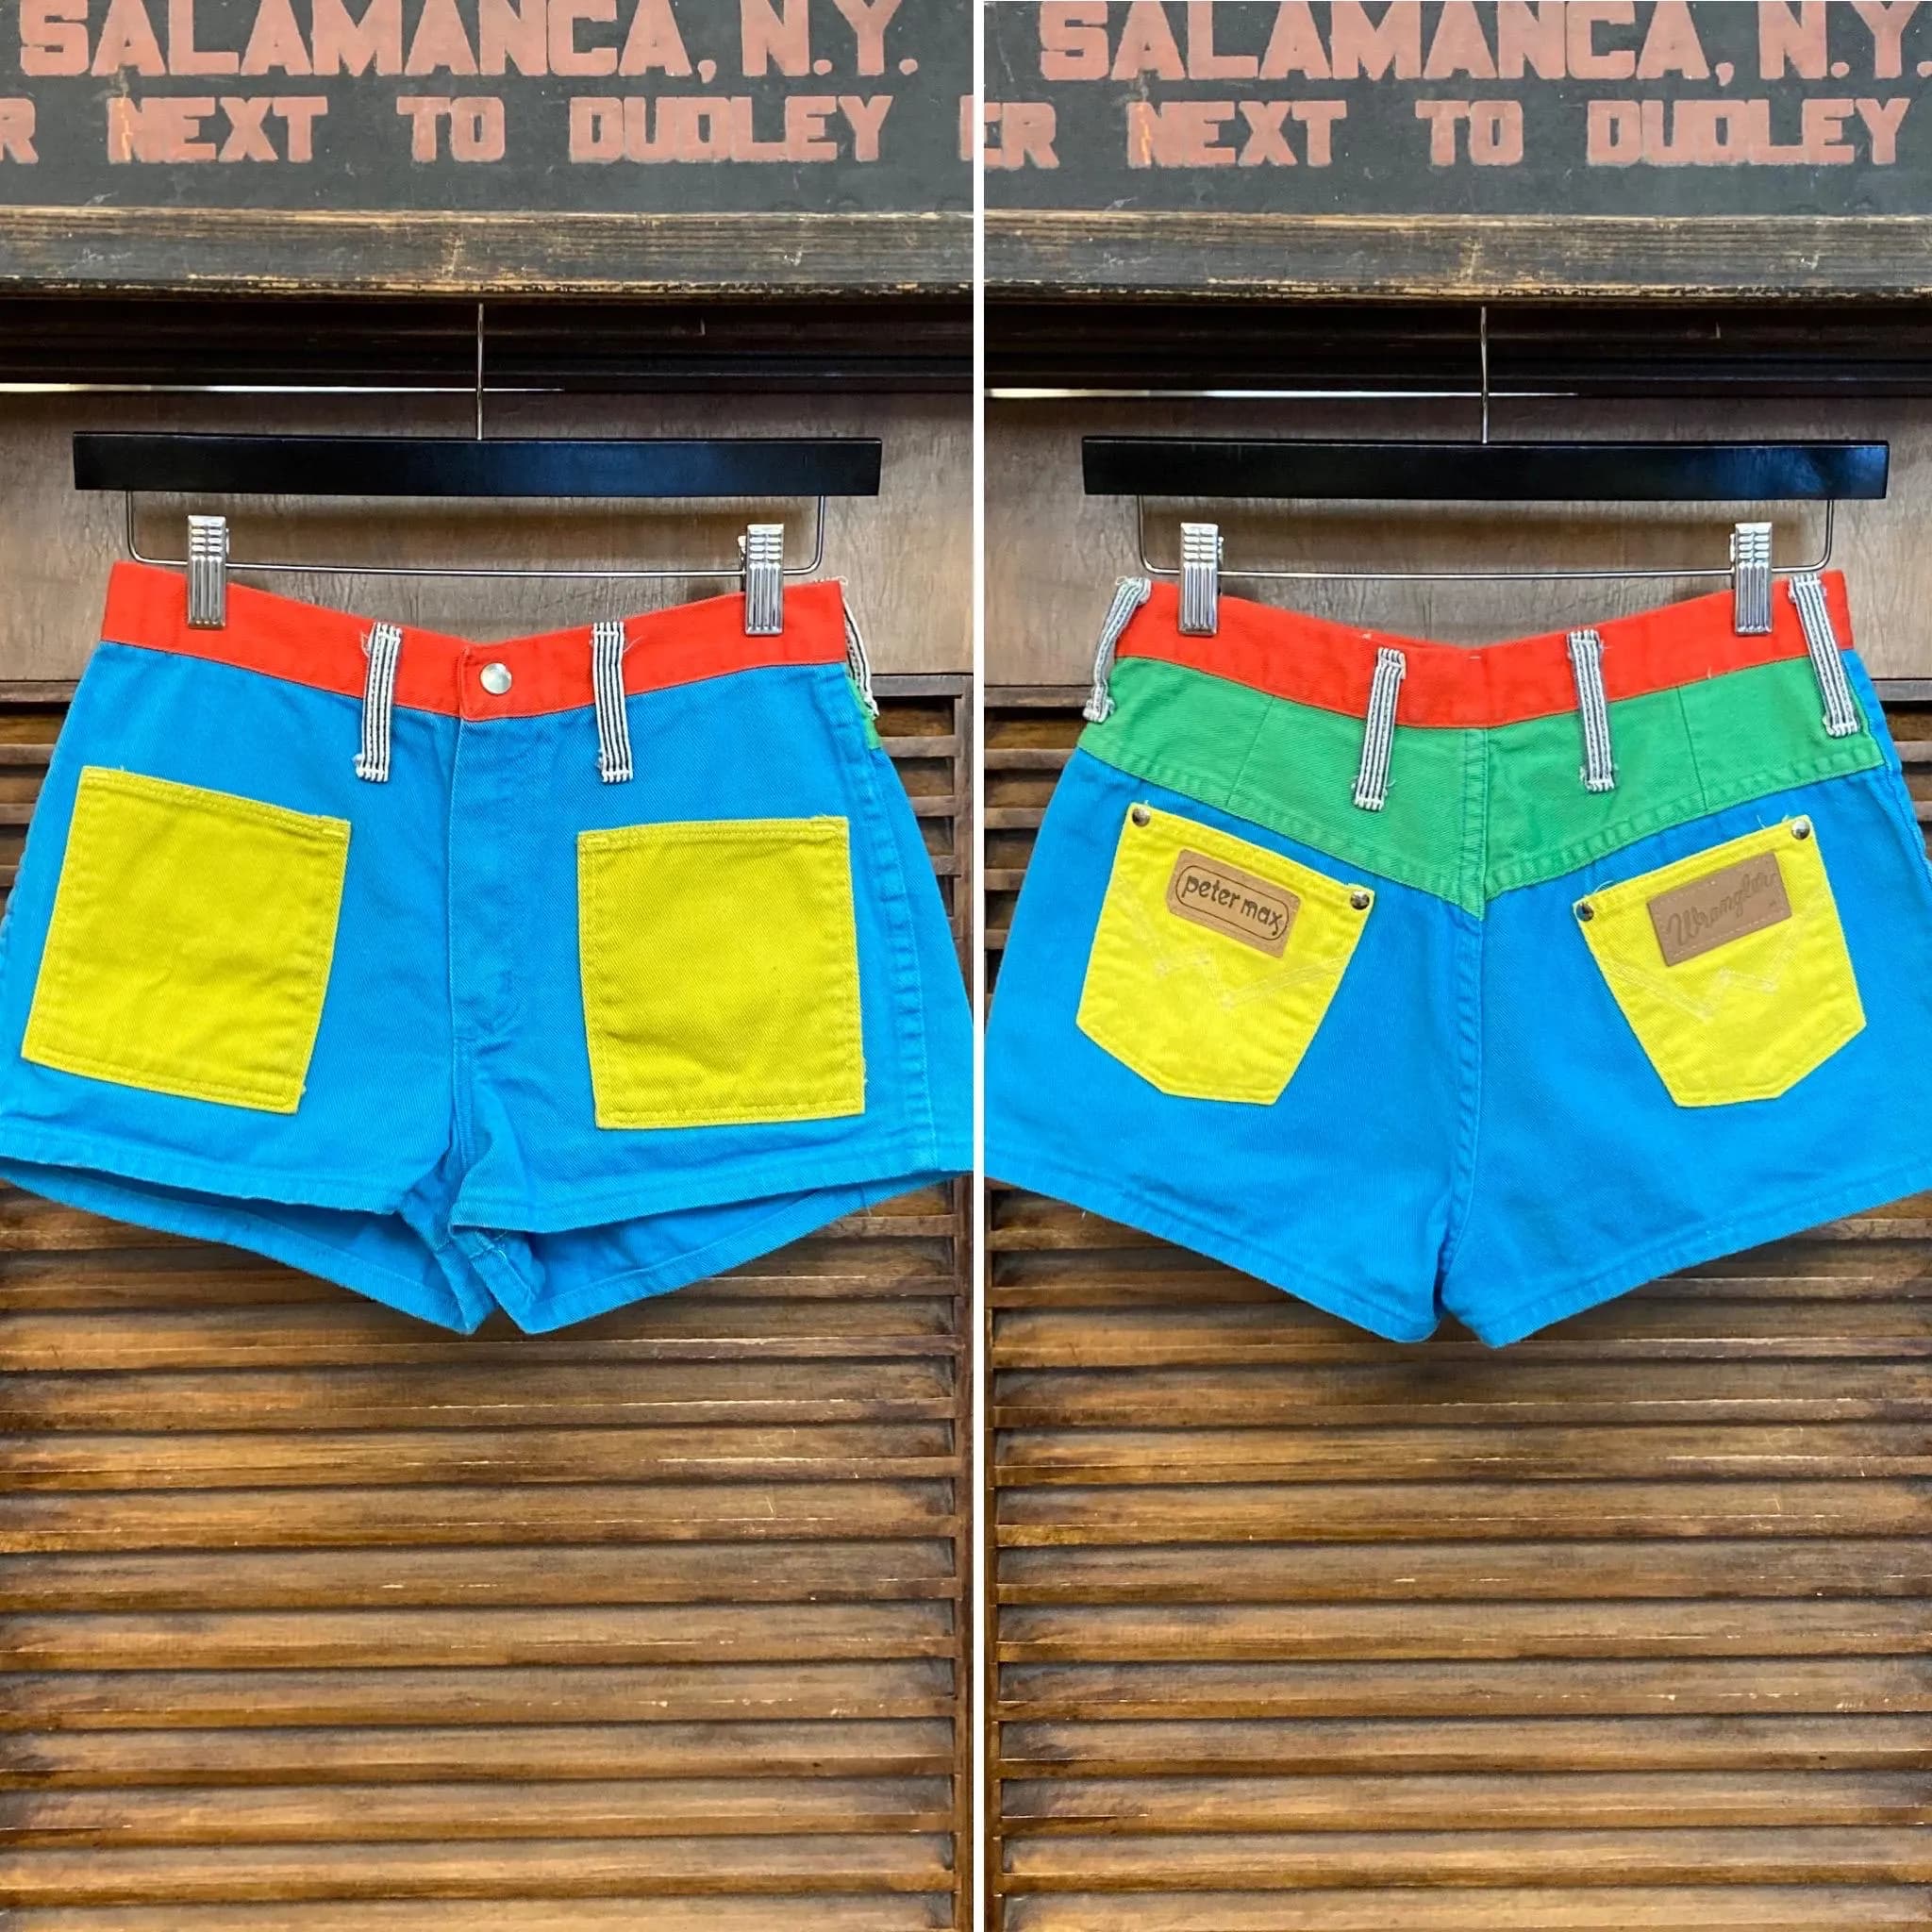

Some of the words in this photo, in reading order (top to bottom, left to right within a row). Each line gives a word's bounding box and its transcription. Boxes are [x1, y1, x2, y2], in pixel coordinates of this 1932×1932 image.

[20, 0, 717, 83] SALAMANCA,
[741, 0, 919, 76] N.Y.
[1039, 1, 1735, 87] SALAMANCA,
[1757, 1, 1932, 79] N.Y.
[107, 96, 328, 163] NEXT
[396, 96, 505, 162] TO
[1126, 101, 1347, 168] NEXT
[1415, 100, 1524, 166] TO
[1181, 875, 1241, 908] peter
[1240, 898, 1283, 936] max
[1667, 872, 1779, 945] Wrangler
